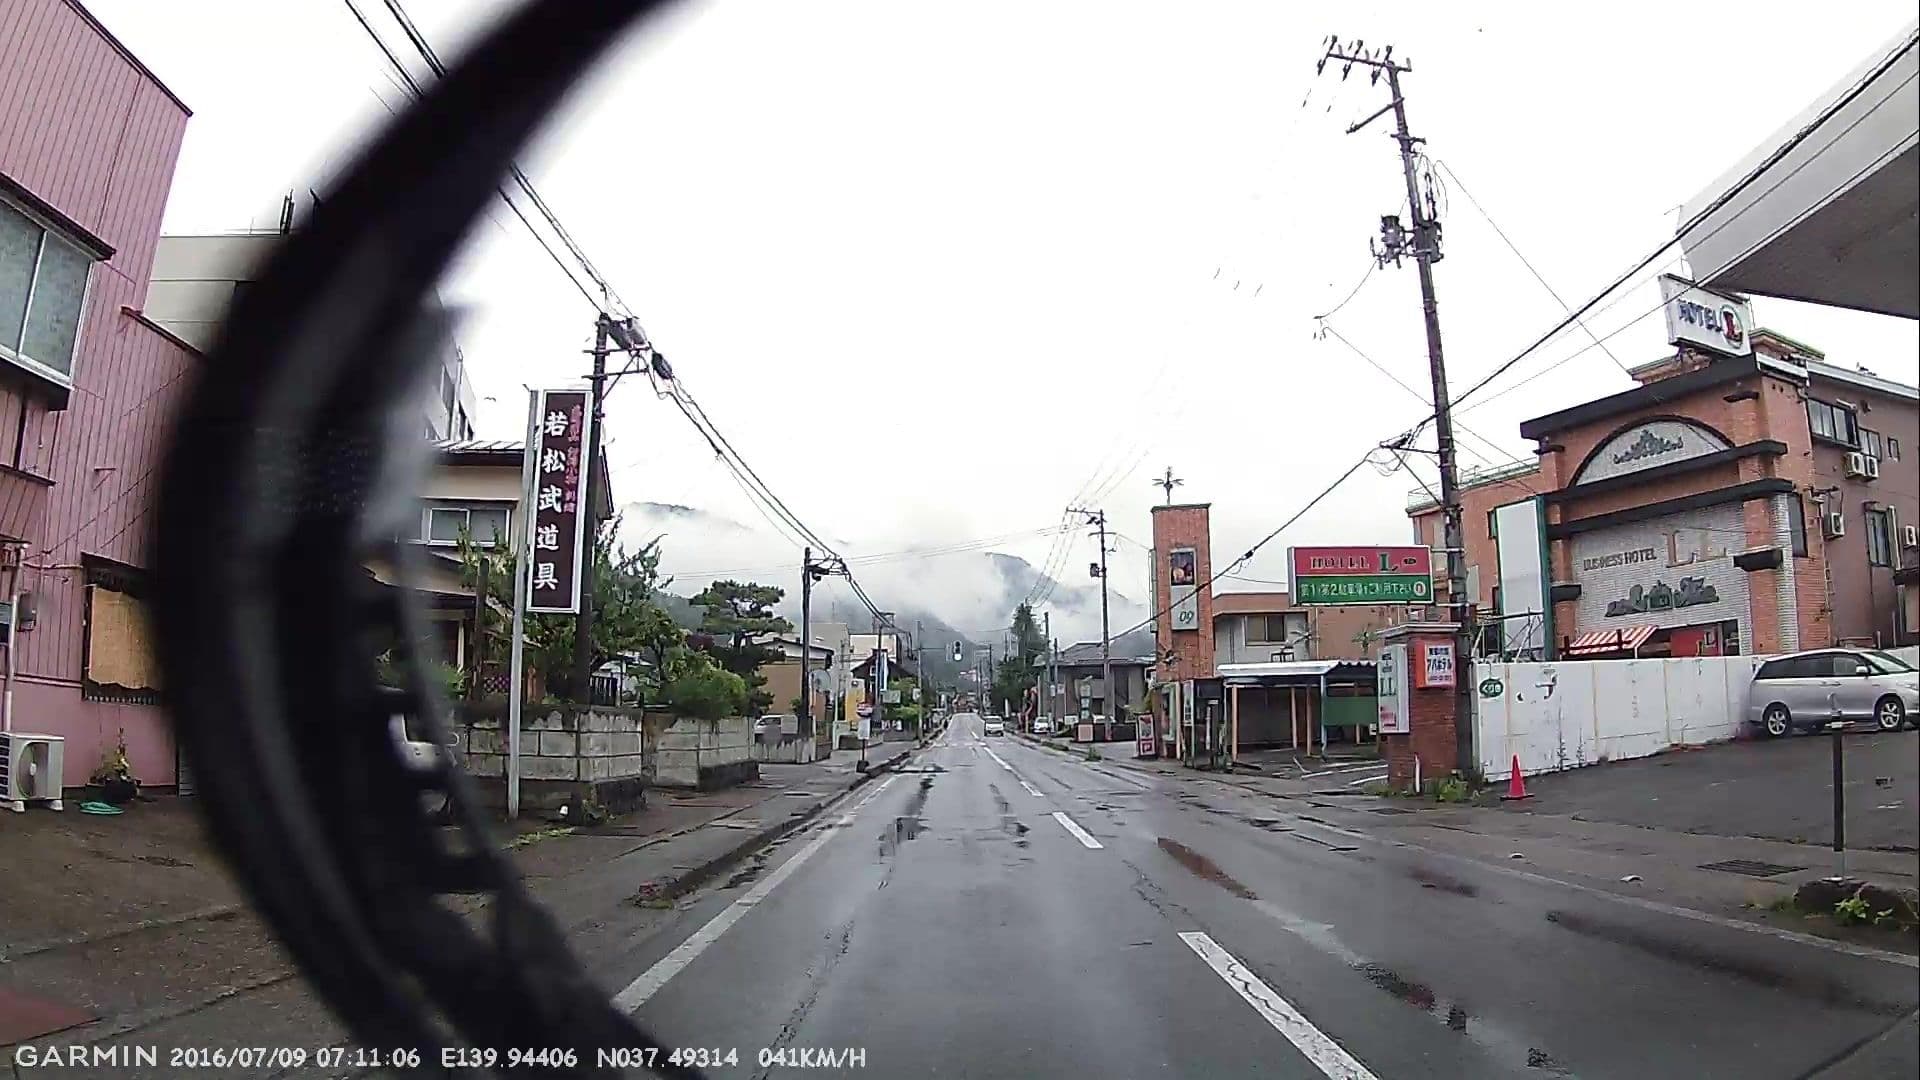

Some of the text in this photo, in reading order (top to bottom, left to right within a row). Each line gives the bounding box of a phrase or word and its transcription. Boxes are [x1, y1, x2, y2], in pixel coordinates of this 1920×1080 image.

[1677, 299, 1722, 332] HOTEL
[533, 411, 568, 590] 若松武道具
[1624, 547, 1657, 565] HOTEL
